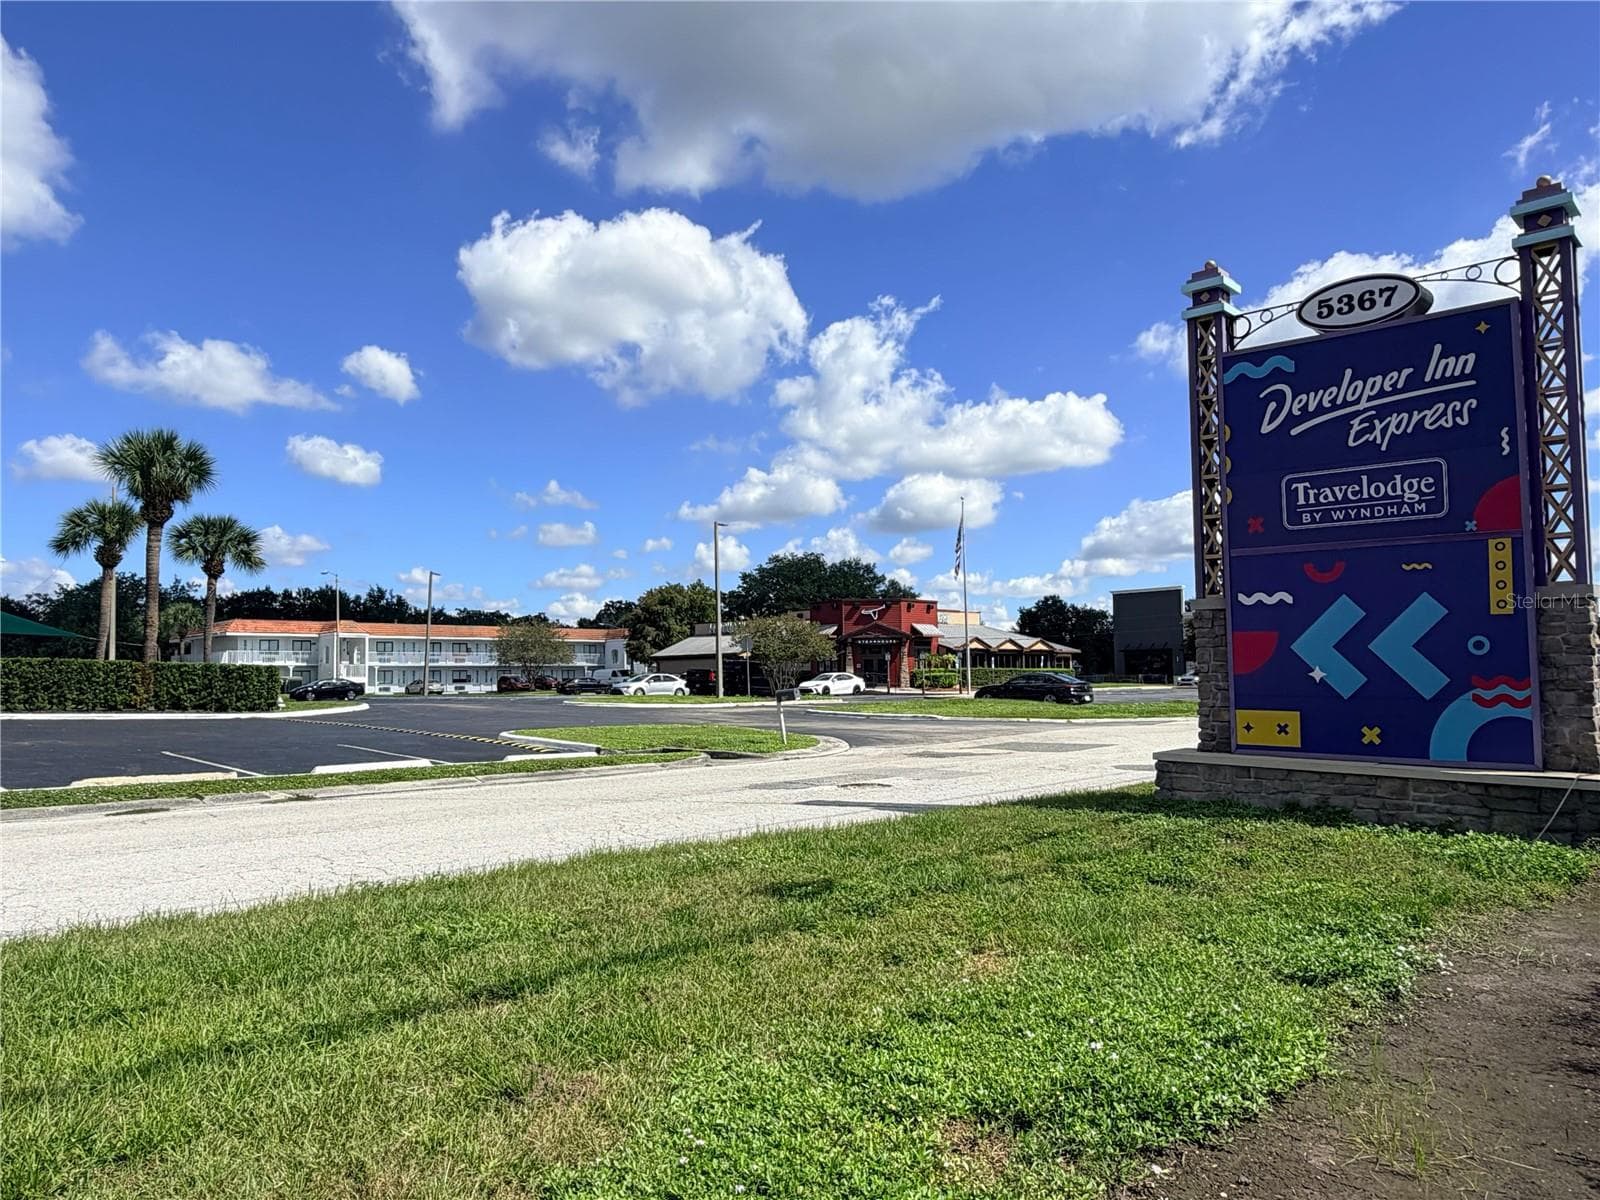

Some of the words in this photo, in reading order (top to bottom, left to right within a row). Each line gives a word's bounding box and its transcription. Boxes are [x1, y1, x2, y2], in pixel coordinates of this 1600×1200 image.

[1316, 284, 1399, 320] 5367
[1259, 367, 1414, 434] Developer
[1424, 343, 1476, 382] Inn
[1347, 398, 1478, 451] Express
[1290, 473, 1436, 506] Travelodge
[1301, 511, 1323, 524] BY
[1331, 502, 1427, 521] WYNDHAM
